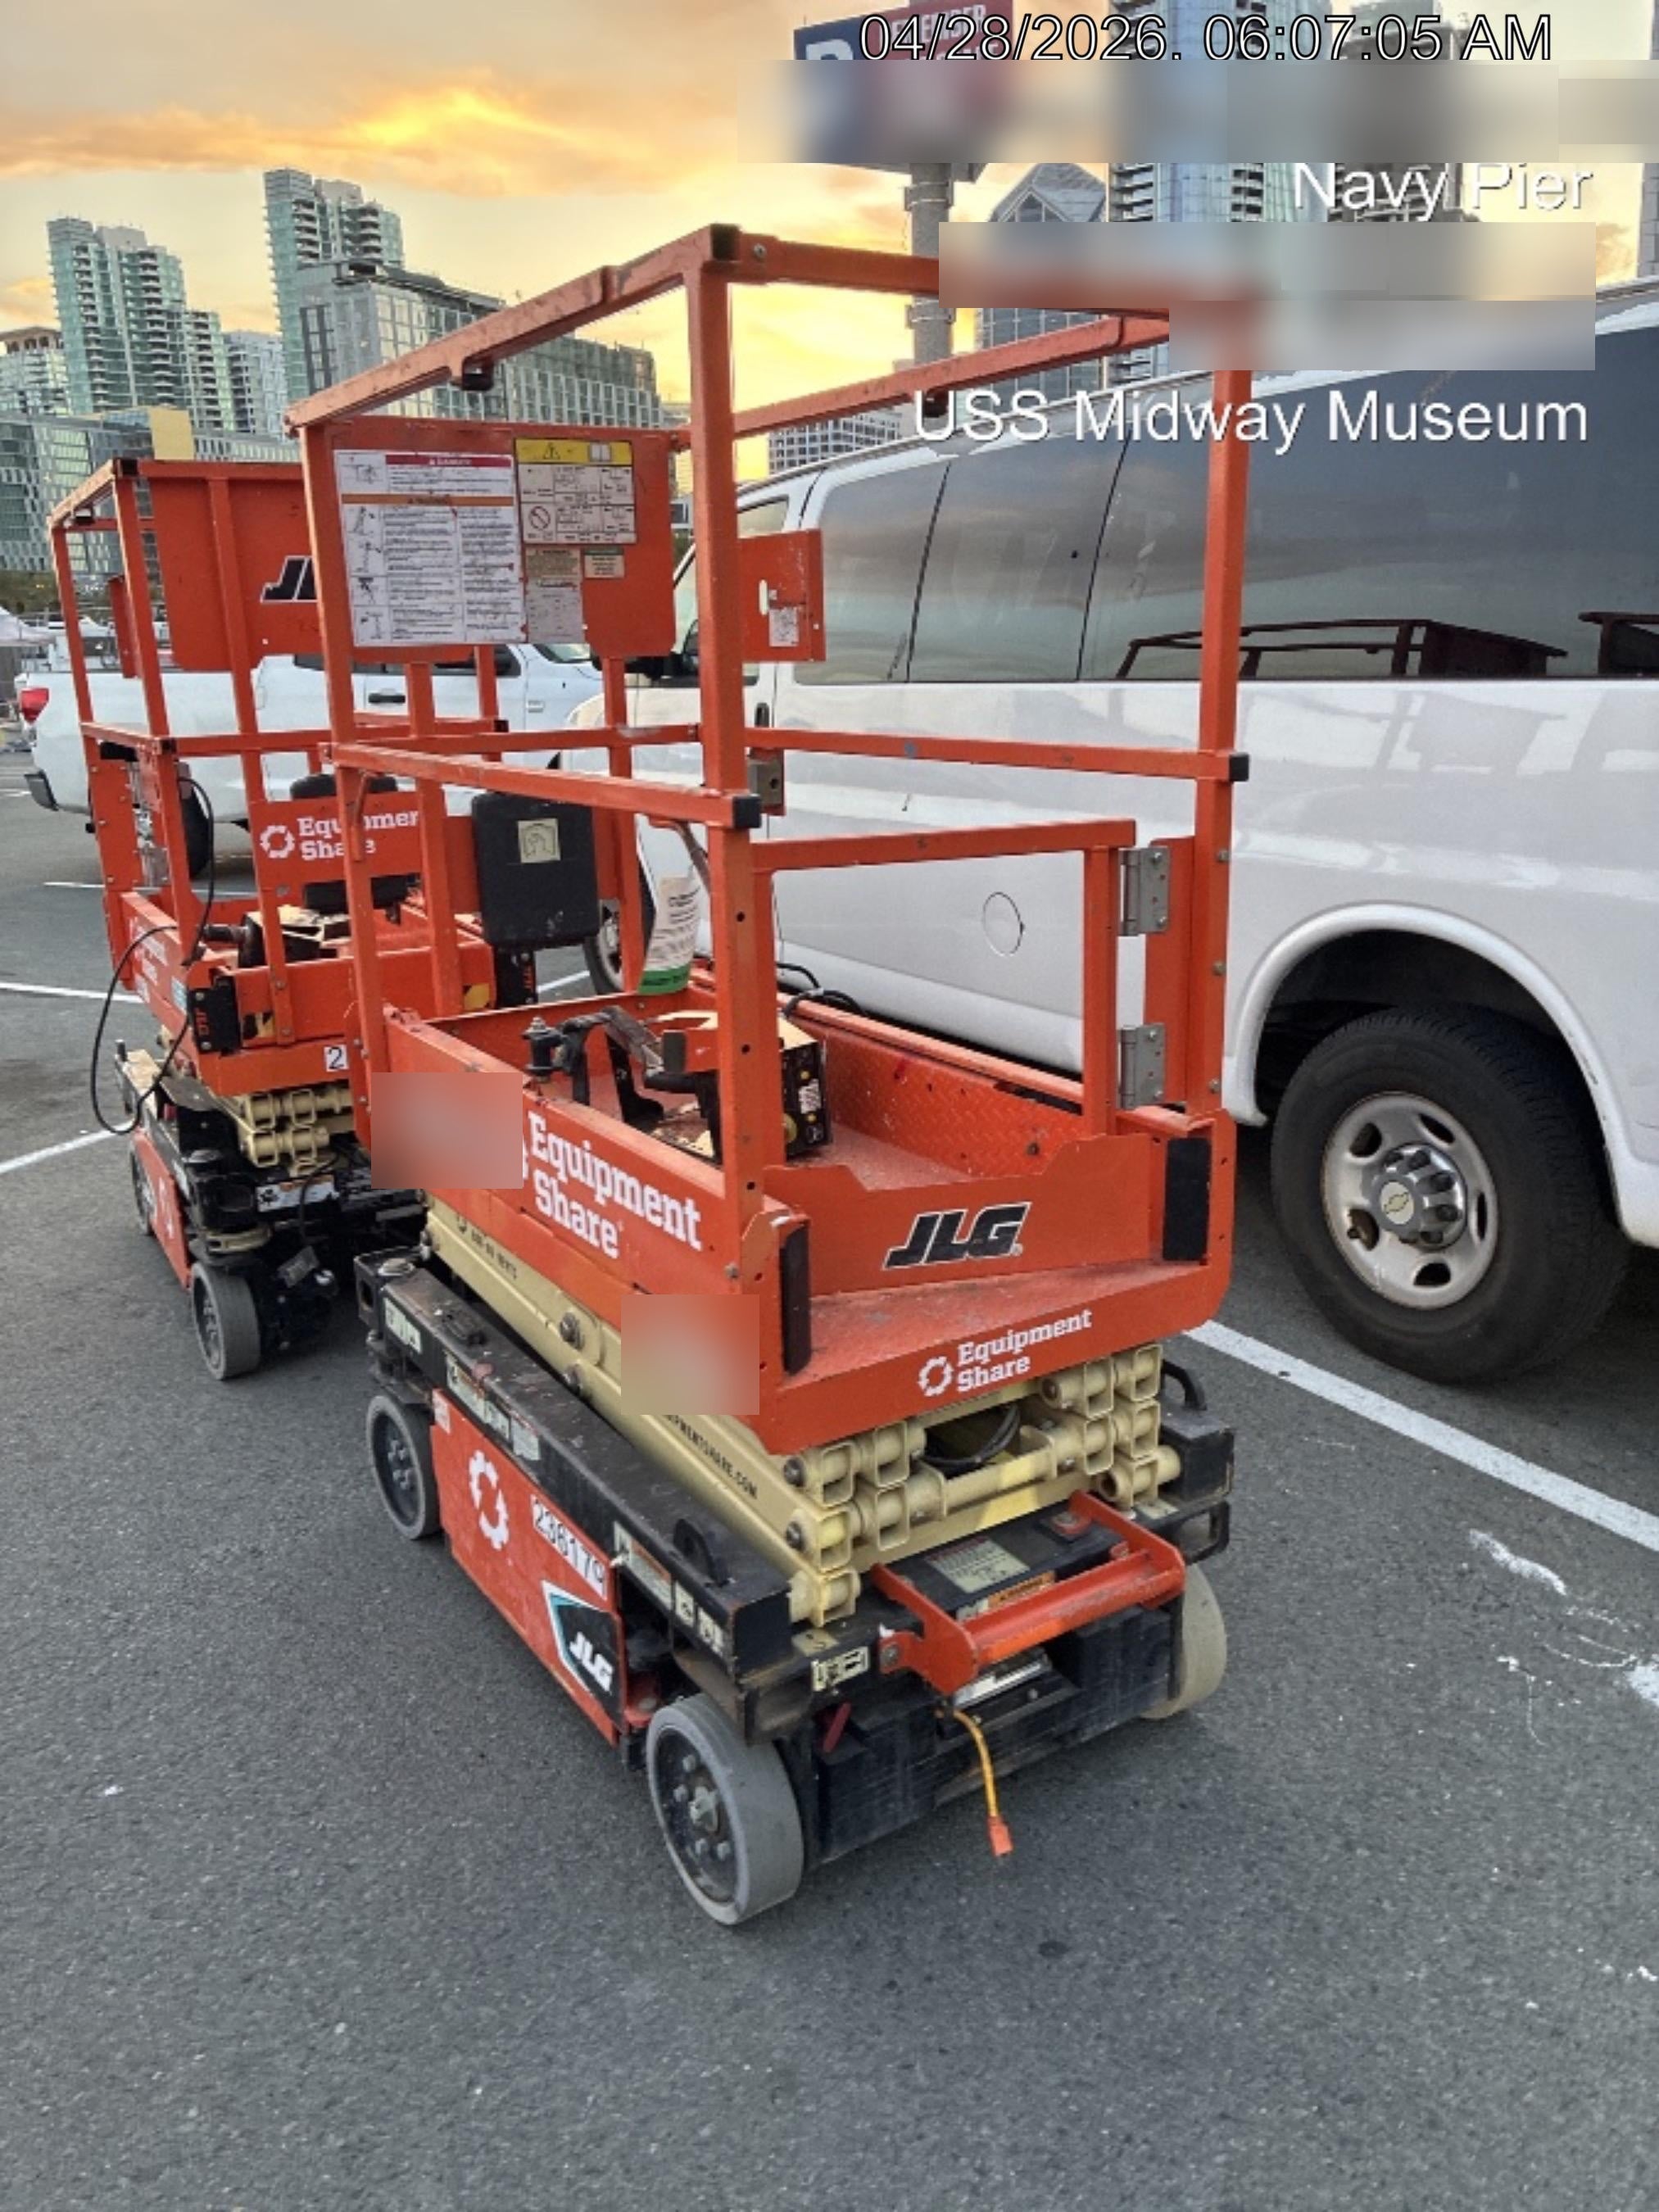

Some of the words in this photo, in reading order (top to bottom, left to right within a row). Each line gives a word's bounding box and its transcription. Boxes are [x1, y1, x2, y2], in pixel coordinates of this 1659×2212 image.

[300, 838, 377, 861] Shae
[329, 1046, 345, 1069] 2
[528, 1110, 703, 1253] Equipment
[533, 1169, 620, 1259] Share
[957, 1308, 1093, 1367] Equipment
[957, 1355, 1031, 1393] Share
[569, 1630, 614, 1693] JLG
